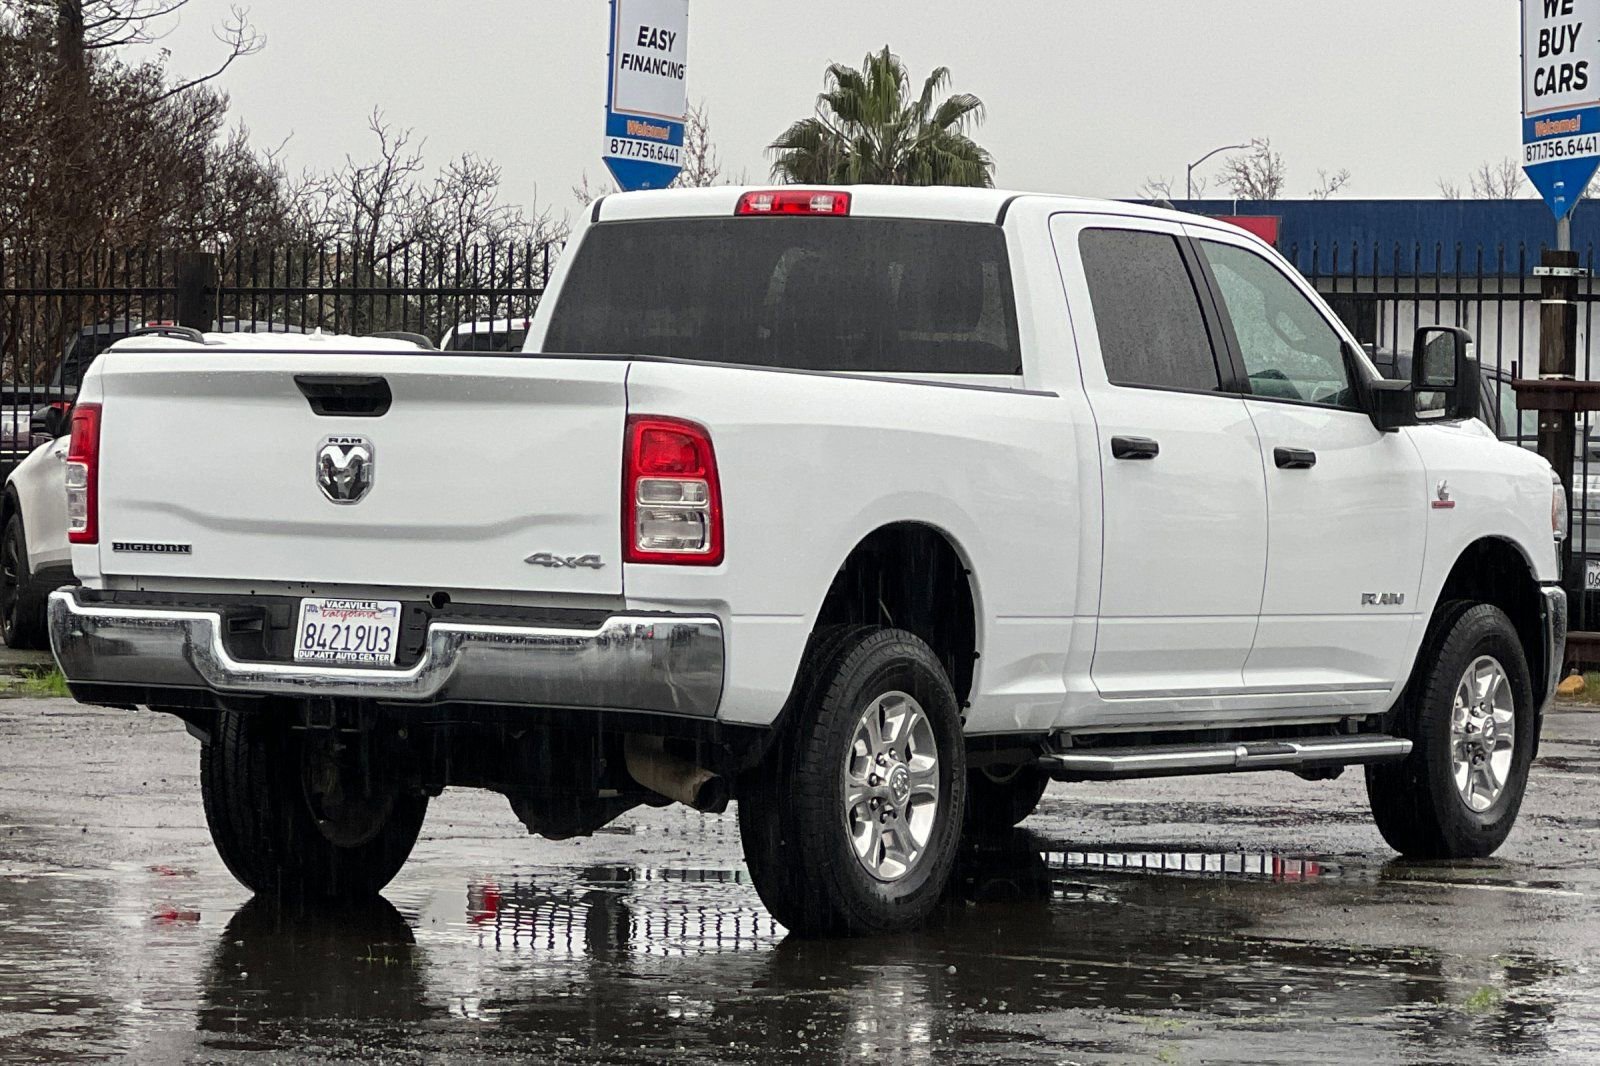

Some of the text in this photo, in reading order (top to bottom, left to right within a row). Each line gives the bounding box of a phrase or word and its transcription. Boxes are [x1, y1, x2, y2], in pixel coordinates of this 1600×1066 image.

[1543, 0, 1574, 19] WE
[637, 25, 676, 52] EASY
[1538, 22, 1582, 58] BUY
[620, 53, 684, 80] FINANCING
[1533, 60, 1588, 97] CARS
[610, 138, 680, 164] 877.756.6441
[1526, 135, 1597, 162] 877.756.6441
[112, 542, 192, 554] BIGHORN
[326, 600, 377, 609] VACAVILLE
[1361, 592, 1405, 605] RAM
[304, 622, 391, 653] 84219U3
[335, 652, 357, 660] AUTO
